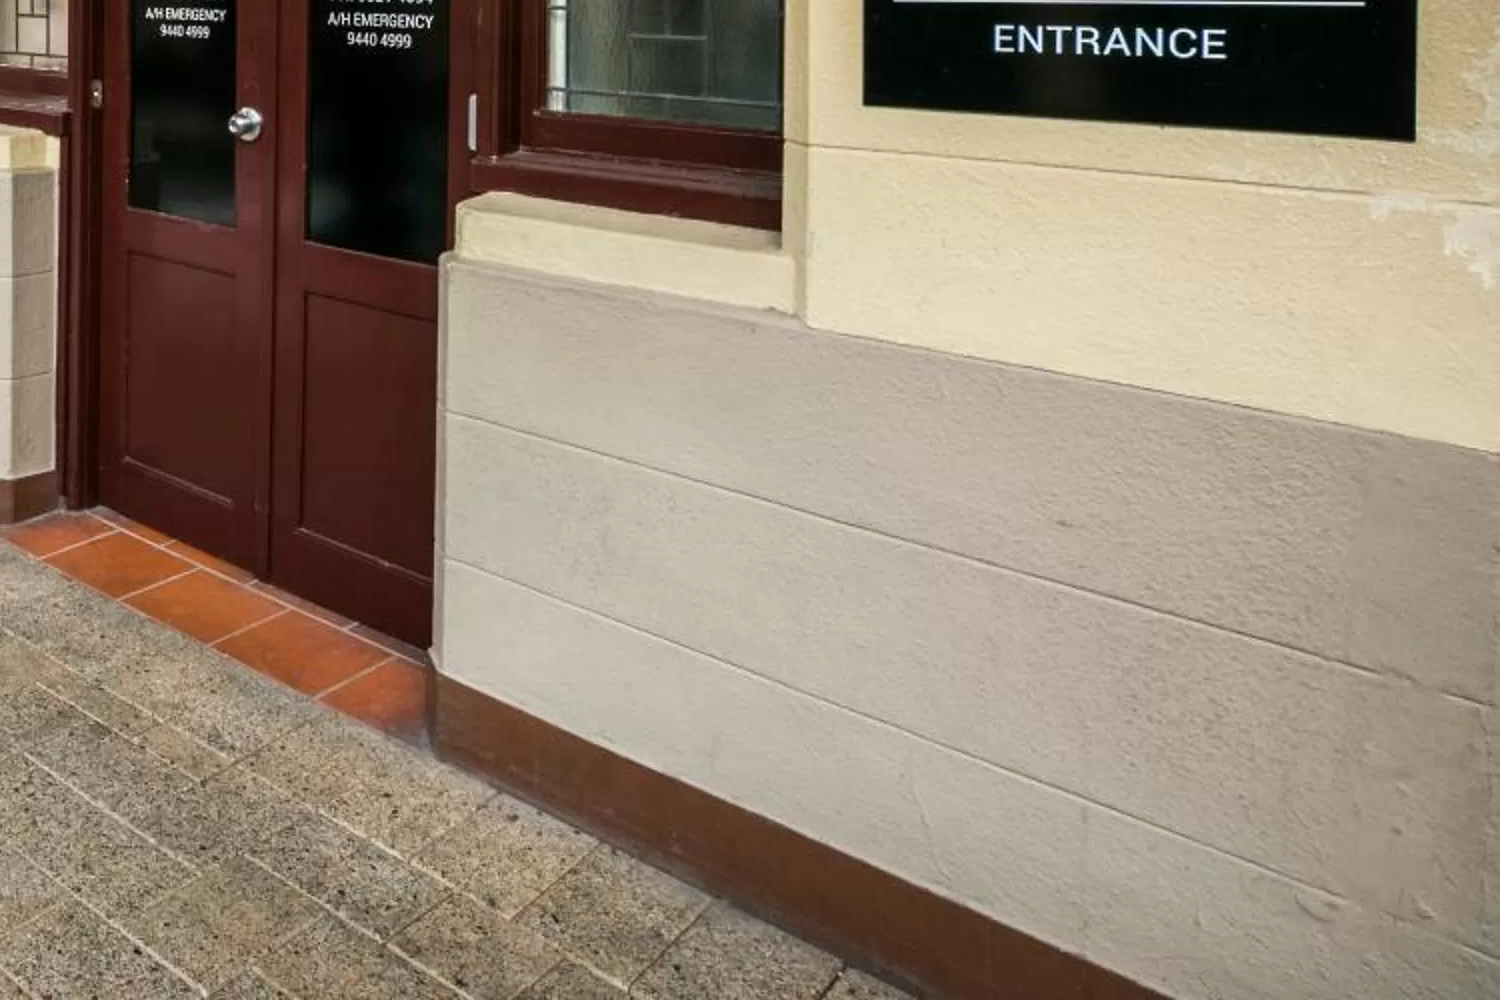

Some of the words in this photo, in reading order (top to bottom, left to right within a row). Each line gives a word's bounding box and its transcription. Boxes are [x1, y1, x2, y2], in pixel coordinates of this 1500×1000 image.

[165, 7, 227, 23] EMERGENCY
[327, 12, 351, 26] A/H
[353, 12, 435, 29] EMERGENCY
[160, 24, 184, 38] 9440
[185, 25, 211, 39] 4999
[347, 31, 378, 47] 9440
[380, 33, 412, 49] 4999
[993, 24, 1228, 60] ENTRANCE
